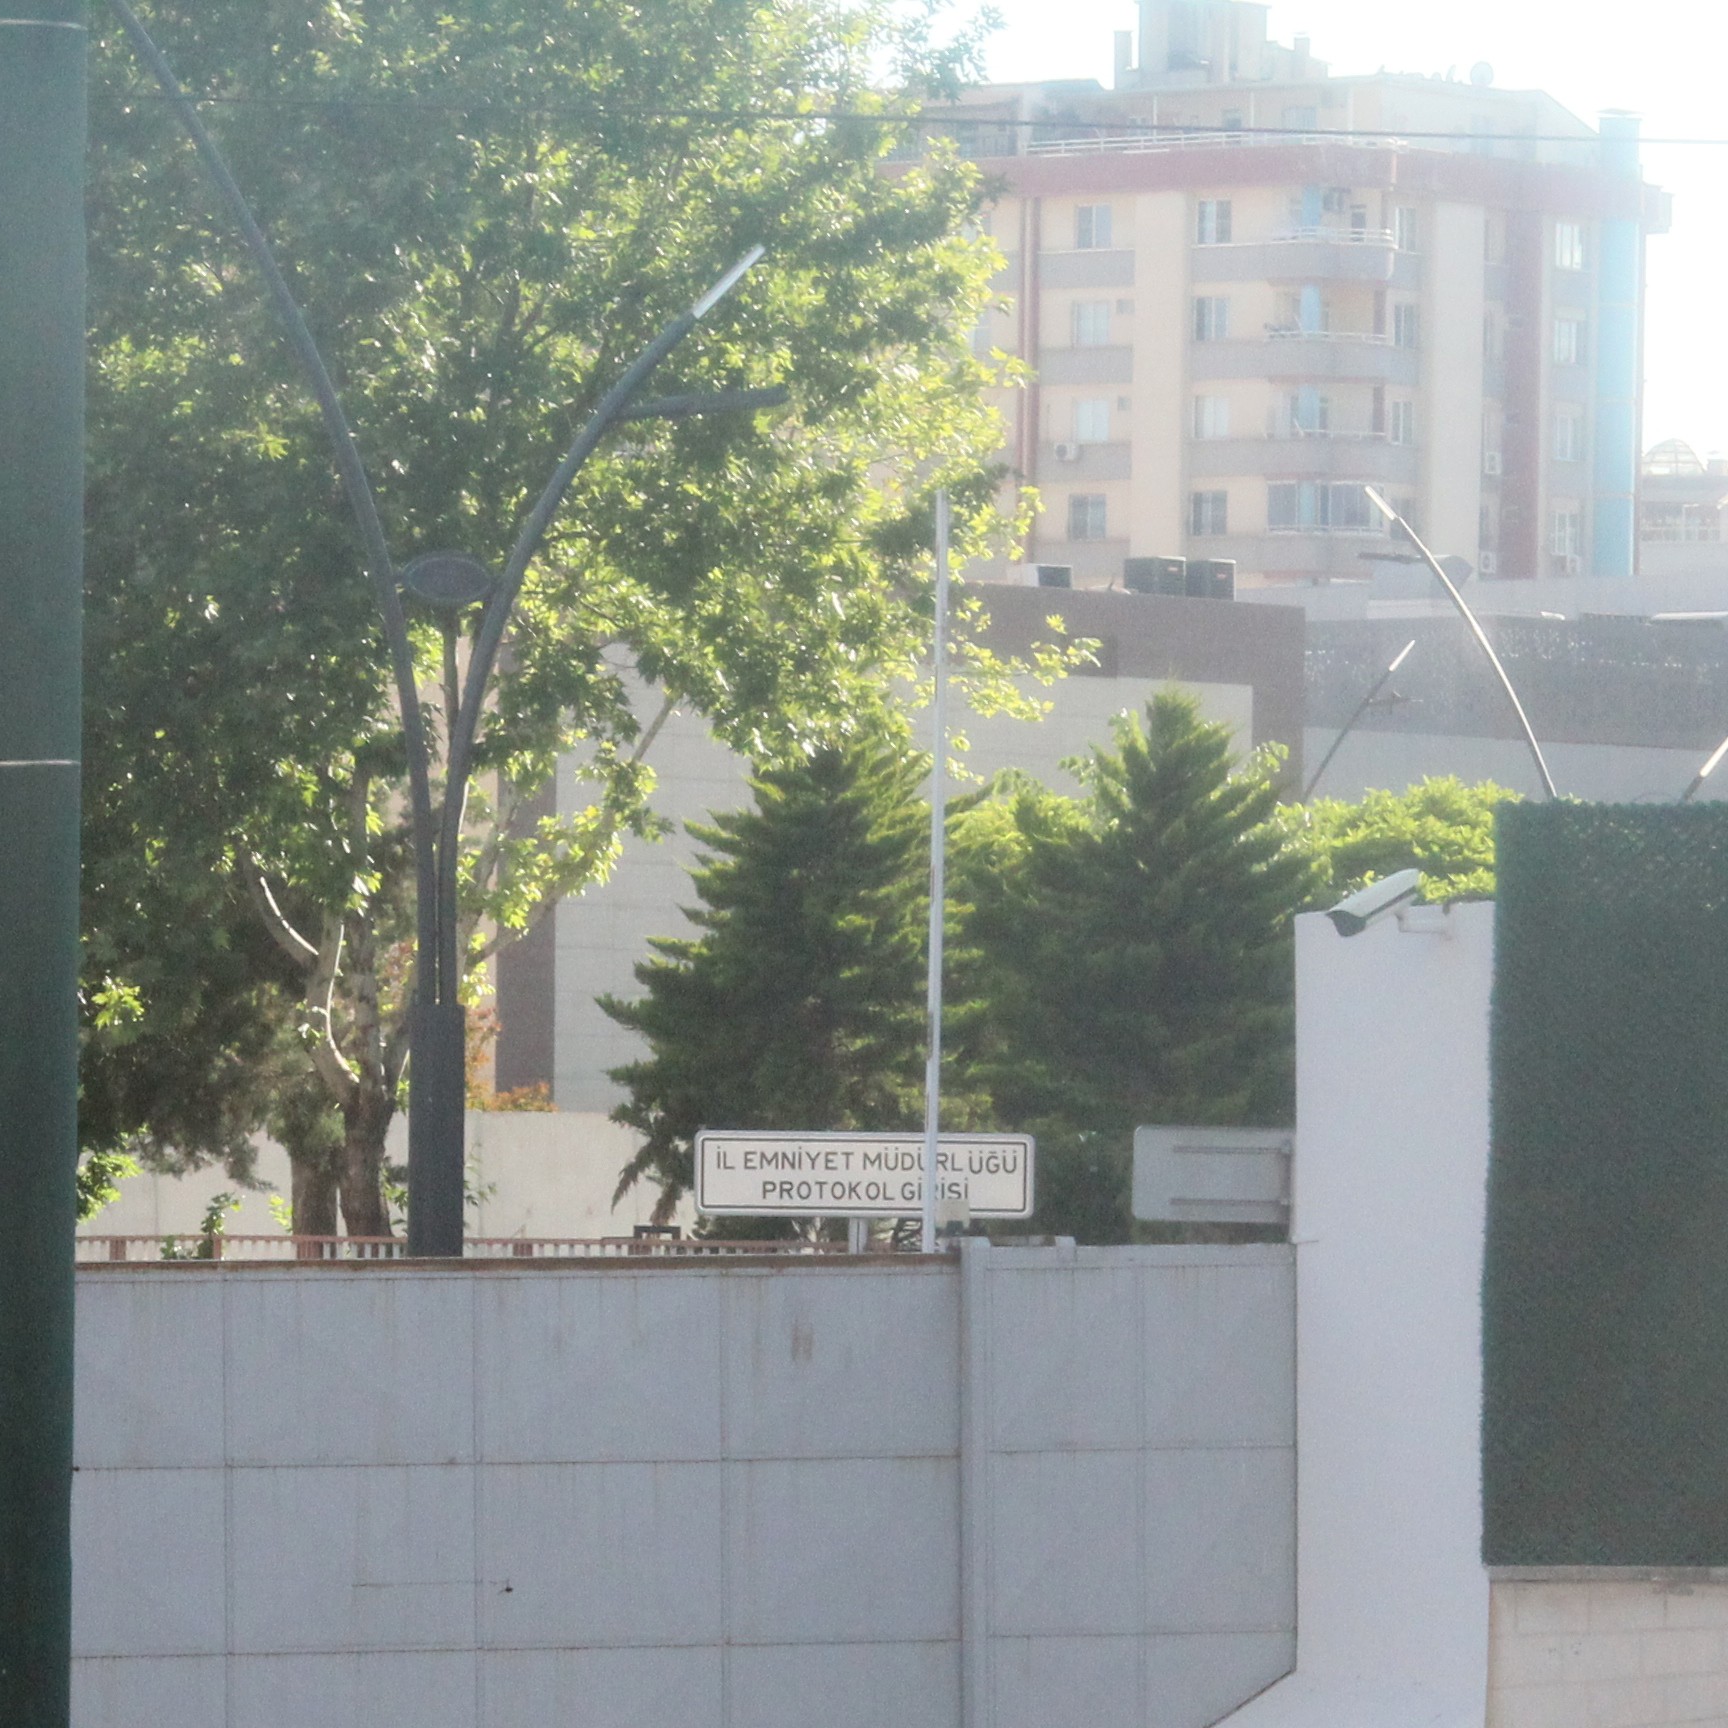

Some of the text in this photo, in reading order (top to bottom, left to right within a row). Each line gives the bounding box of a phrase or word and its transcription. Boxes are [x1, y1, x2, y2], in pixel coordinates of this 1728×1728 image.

[716, 1145, 736, 1170] İL
[743, 1145, 854, 1171] EMNİYET
[761, 1180, 895, 1201] PROTOKOL
